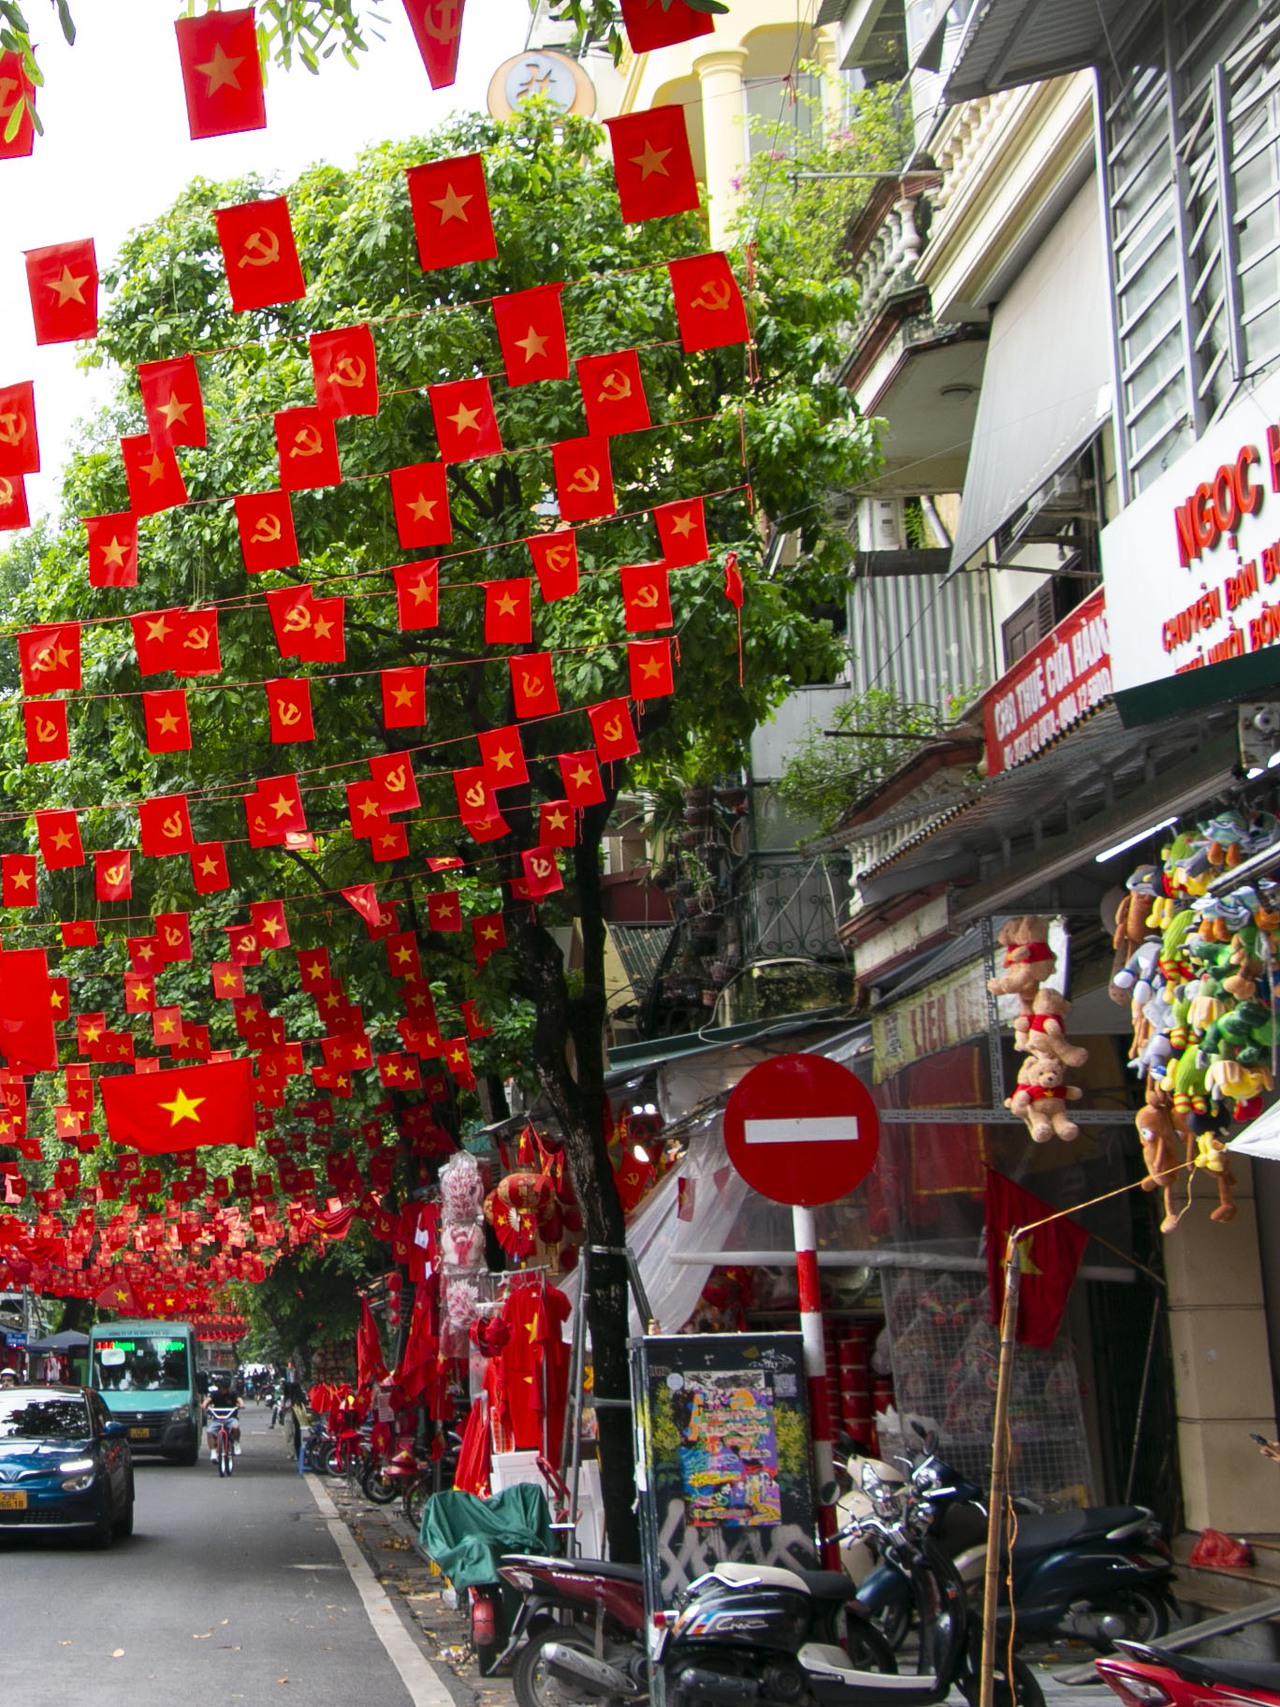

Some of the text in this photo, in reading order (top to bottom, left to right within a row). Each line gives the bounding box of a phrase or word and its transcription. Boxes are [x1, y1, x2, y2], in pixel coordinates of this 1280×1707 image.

[1174, 444, 1264, 569] NGỌC
[1224, 556, 1260, 612] BÁN
[1015, 658, 1047, 724] THUÊ
